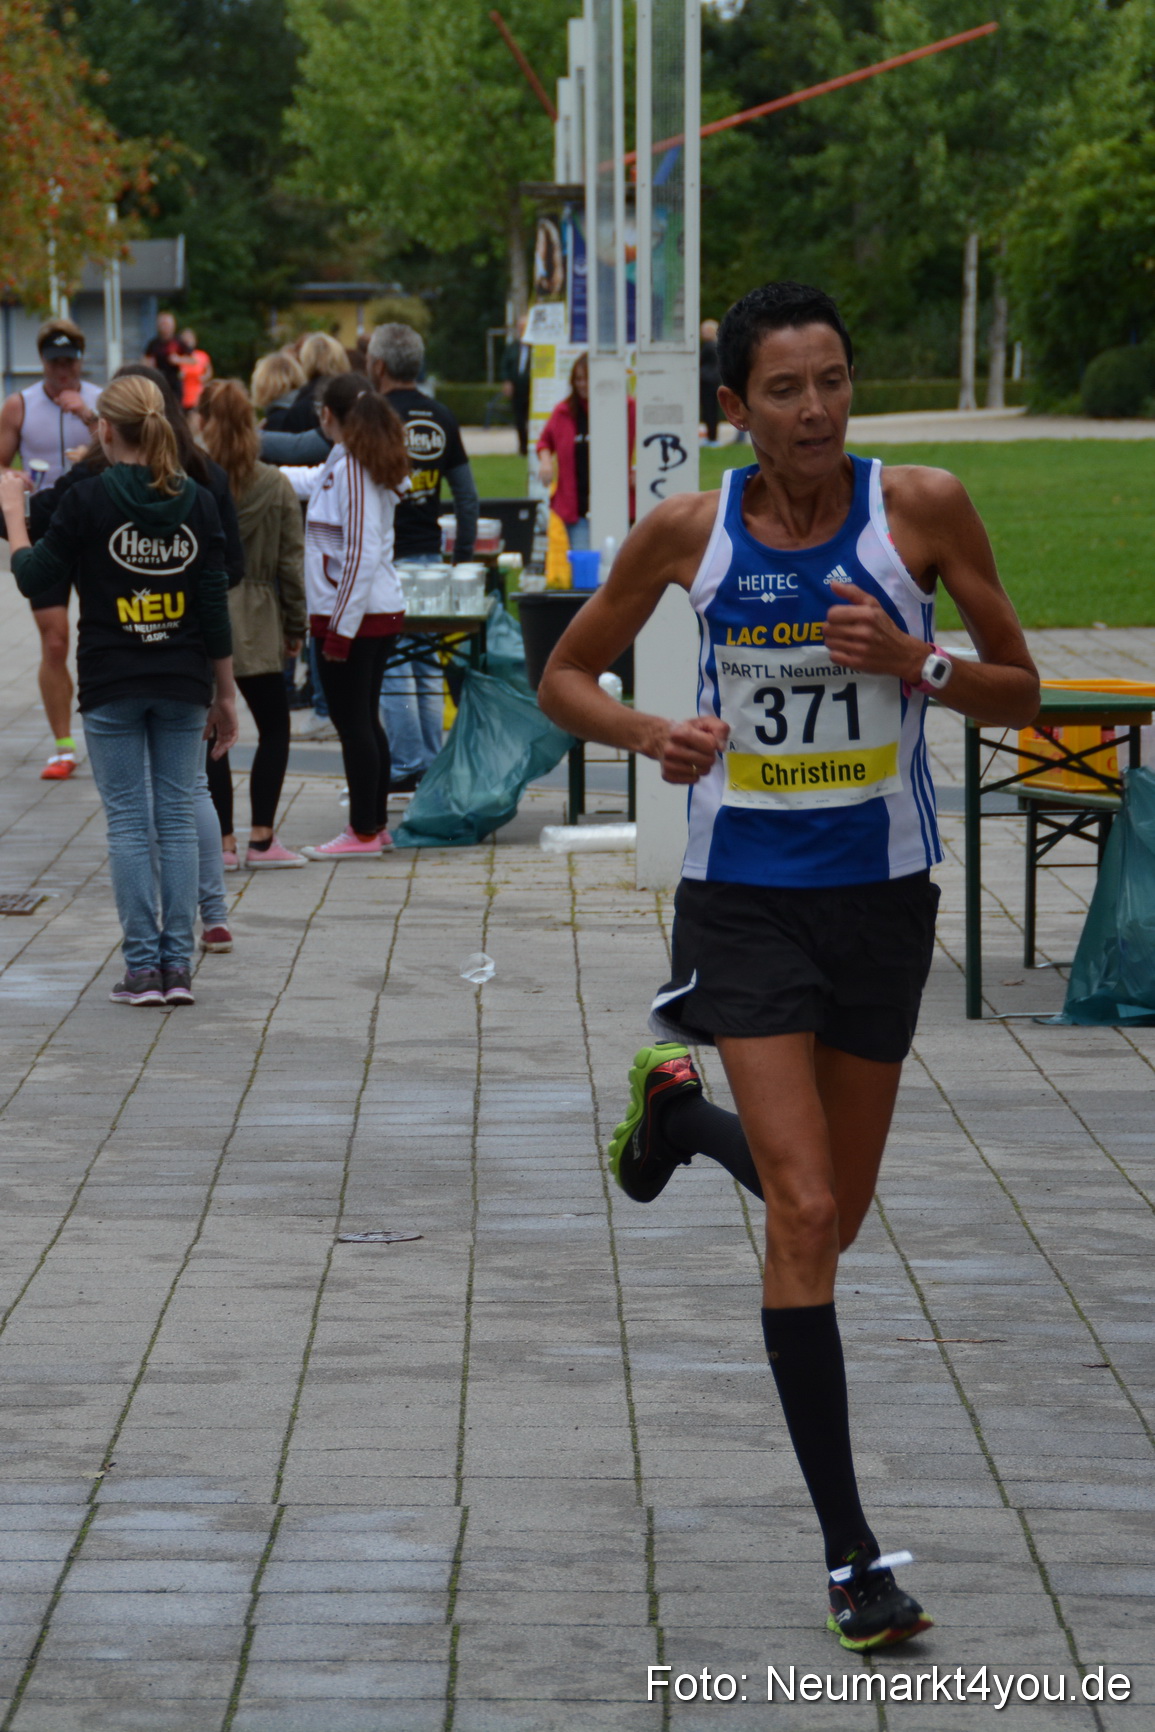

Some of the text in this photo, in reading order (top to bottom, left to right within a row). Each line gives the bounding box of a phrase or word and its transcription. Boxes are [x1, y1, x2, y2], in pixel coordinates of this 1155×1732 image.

[120, 530, 190, 562] Hervis
[126, 556, 161, 564] SPORTS
[738, 573, 799, 592] HEITEC
[116, 591, 186, 623] NEU
[726, 625, 768, 646] LAC
[721, 661, 776, 679] PARTL
[753, 682, 861, 746] 371
[761, 760, 866, 786] Christine
